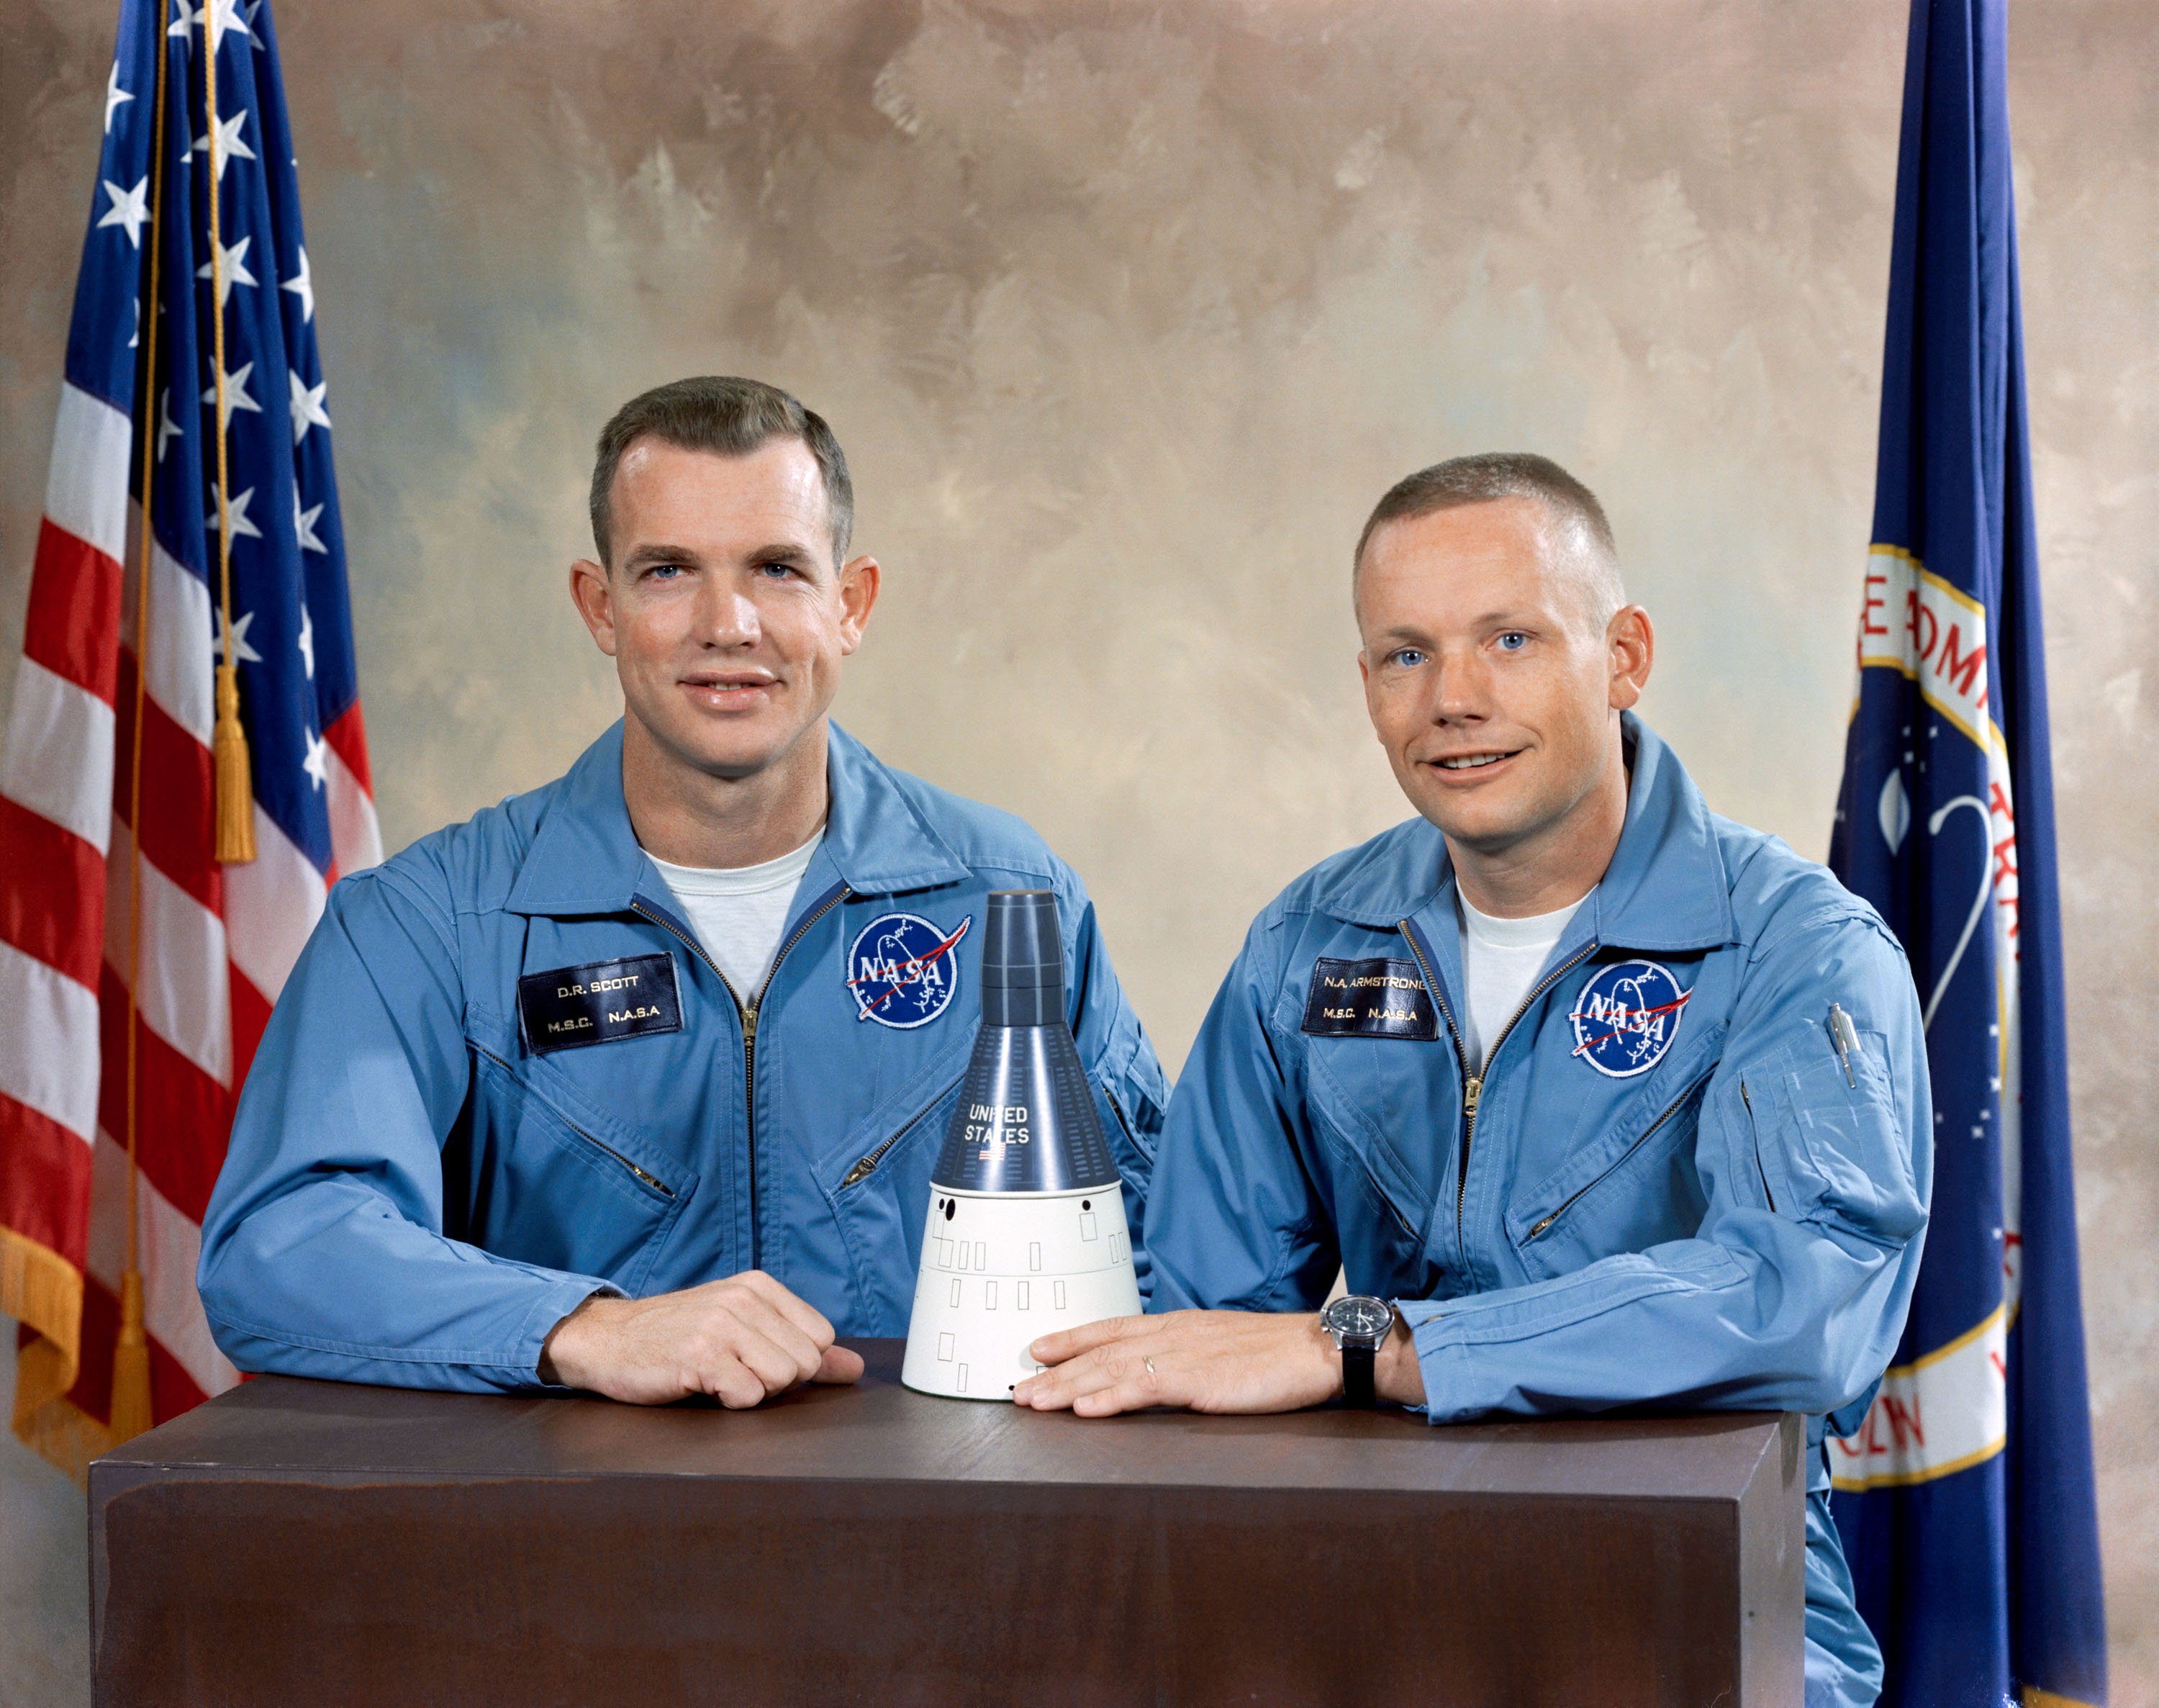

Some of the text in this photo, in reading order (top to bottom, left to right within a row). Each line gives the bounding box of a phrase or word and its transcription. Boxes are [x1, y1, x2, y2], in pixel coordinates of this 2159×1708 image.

[861, 957, 943, 985] NASA
[1324, 977, 1347, 988] N.A.
[558, 976, 638, 998] D.R. SCOTT
[548, 1006, 660, 1032] M.S.C. N.A.S.A
[1323, 1008, 1417, 1021] M.S.C. N.A.S.A
[1585, 993, 1665, 1041] NASA
